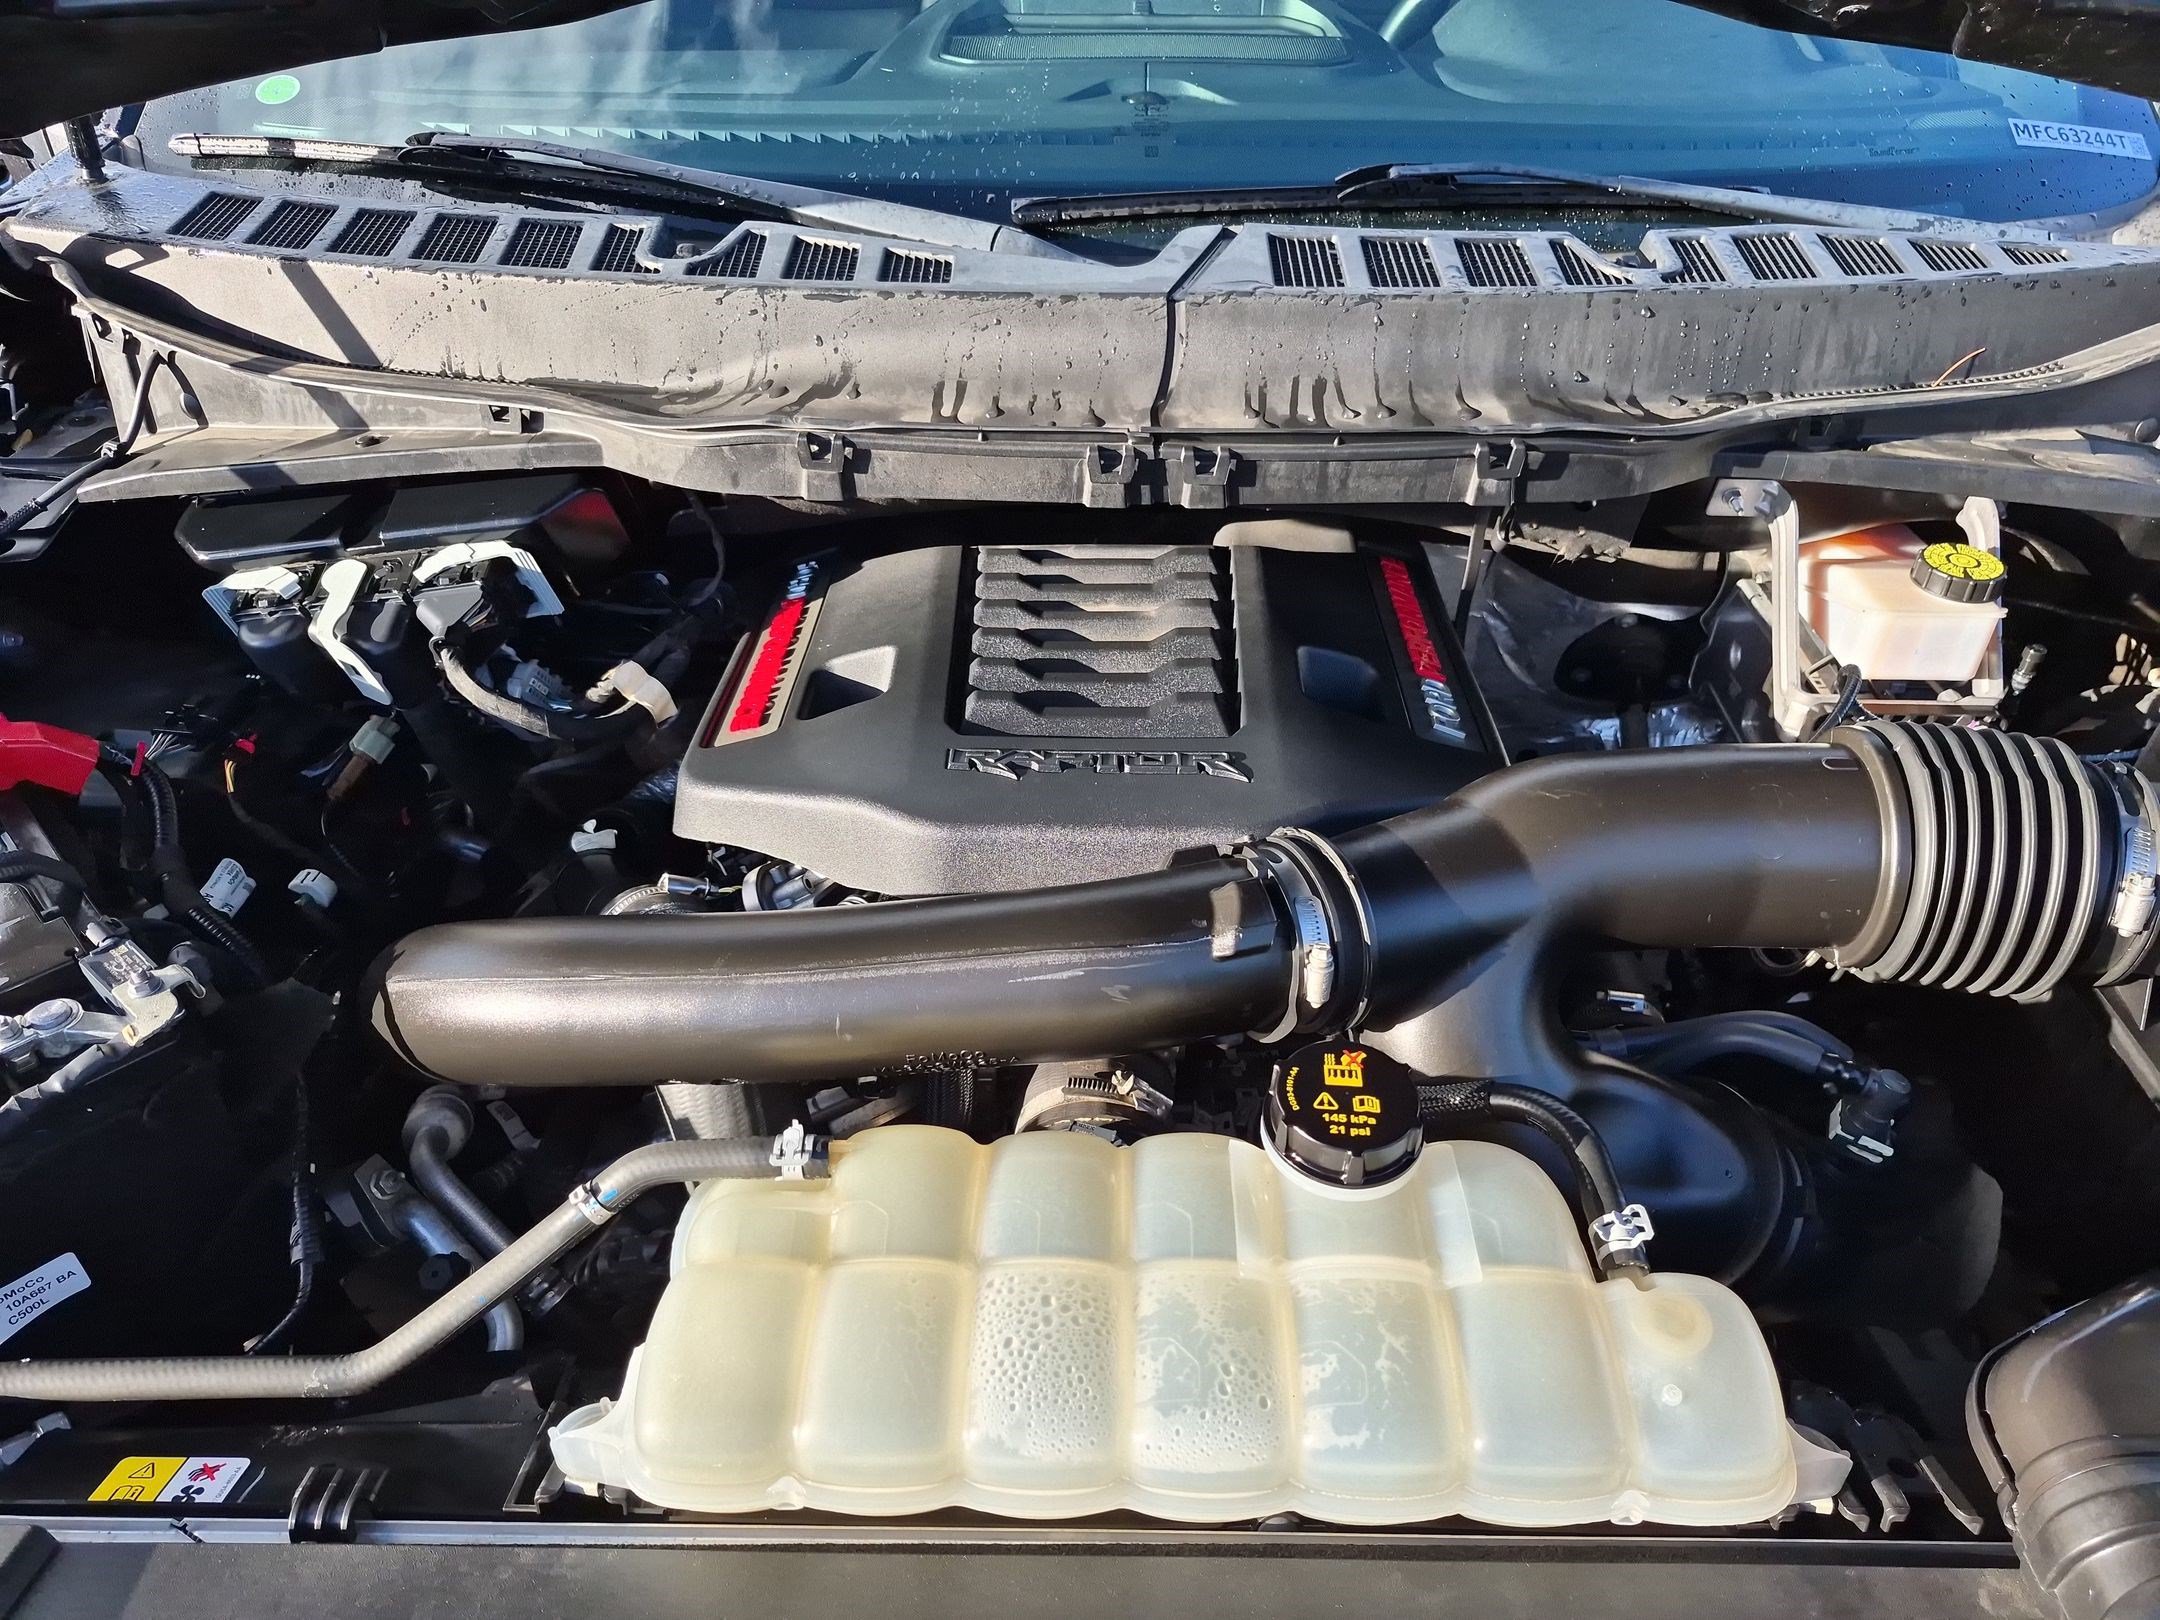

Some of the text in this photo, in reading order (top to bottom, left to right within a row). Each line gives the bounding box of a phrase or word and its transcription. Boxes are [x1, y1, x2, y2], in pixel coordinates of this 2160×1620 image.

[2013, 123, 2126, 149] MFC63244T
[1421, 678, 1467, 739] FORD
[947, 748, 1251, 783] RAPTOR
[1322, 1113, 1377, 1125] 145 kPa
[1329, 1125, 1371, 1137] 21 psi
[5, 1270, 78, 1312] 10A687 BA
[8, 1297, 50, 1326] C500L
